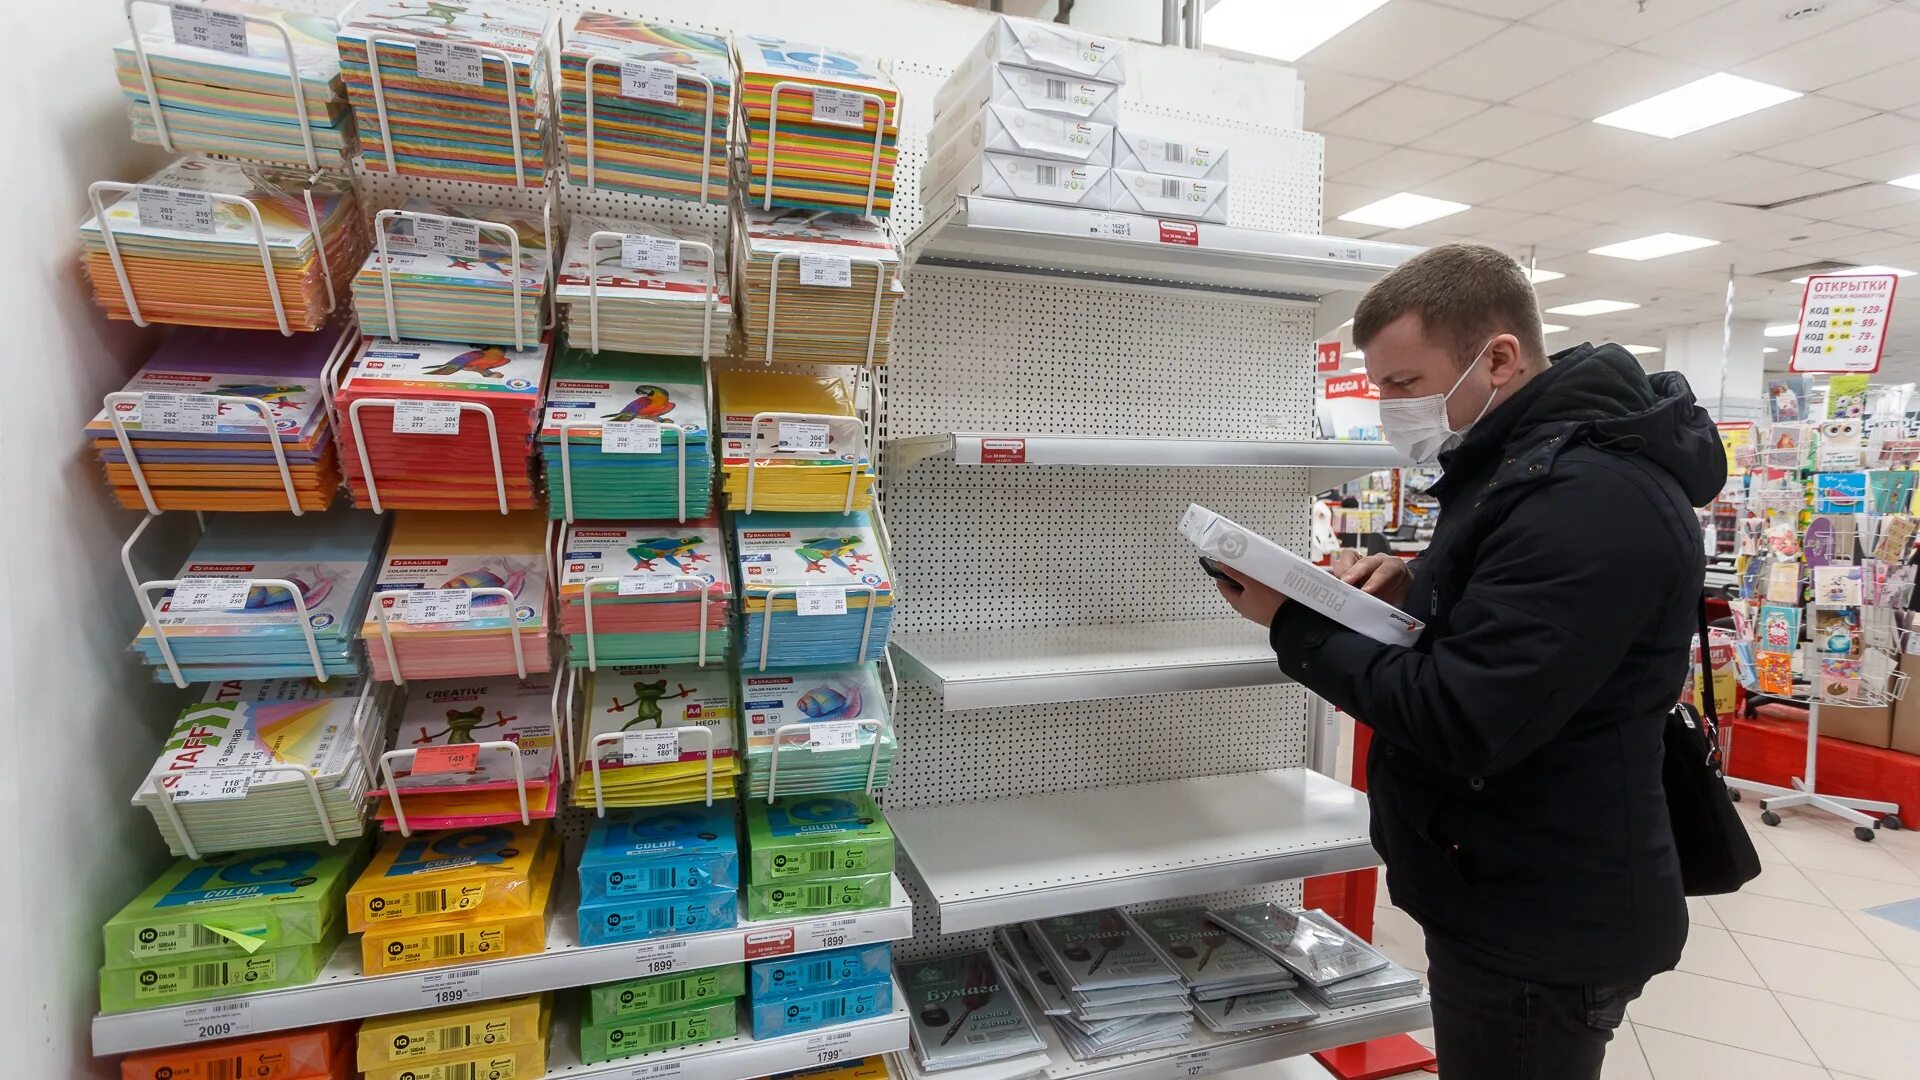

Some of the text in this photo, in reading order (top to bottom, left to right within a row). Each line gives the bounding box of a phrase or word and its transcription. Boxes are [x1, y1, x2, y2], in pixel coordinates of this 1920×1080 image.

[1815, 280, 1887, 292] ОТКРЫТКИ
[1810, 307, 1829, 315] КОД
[1328, 380, 1359, 393] КАССА
[1282, 570, 1346, 613] PREMIUM
[1389, 612, 1413, 627] mondi
[425, 687, 488, 699] CREATIVE
[163, 727, 213, 788] STAFF
[636, 840, 676, 850] COLOR
[425, 855, 472, 868] COLOR
[171, 851, 320, 890] IQ
[205, 886, 260, 899] COLOR
[372, 899, 383, 908] IQ
[142, 932, 155, 941] IQ
[822, 936, 843, 947] 1899
[1066, 930, 1131, 942] Бумага
[390, 944, 402, 953] IQ
[648, 960, 672, 972] 1899
[142, 973, 155, 983] IQ
[435, 990, 462, 1003] 1899
[927, 984, 1000, 1002] Бумага
[199, 1023, 231, 1038] 2009
[396, 1039, 407, 1047] IQ
[817, 1050, 839, 1062] 1799
[1187, 1066, 1200, 1075] 127
